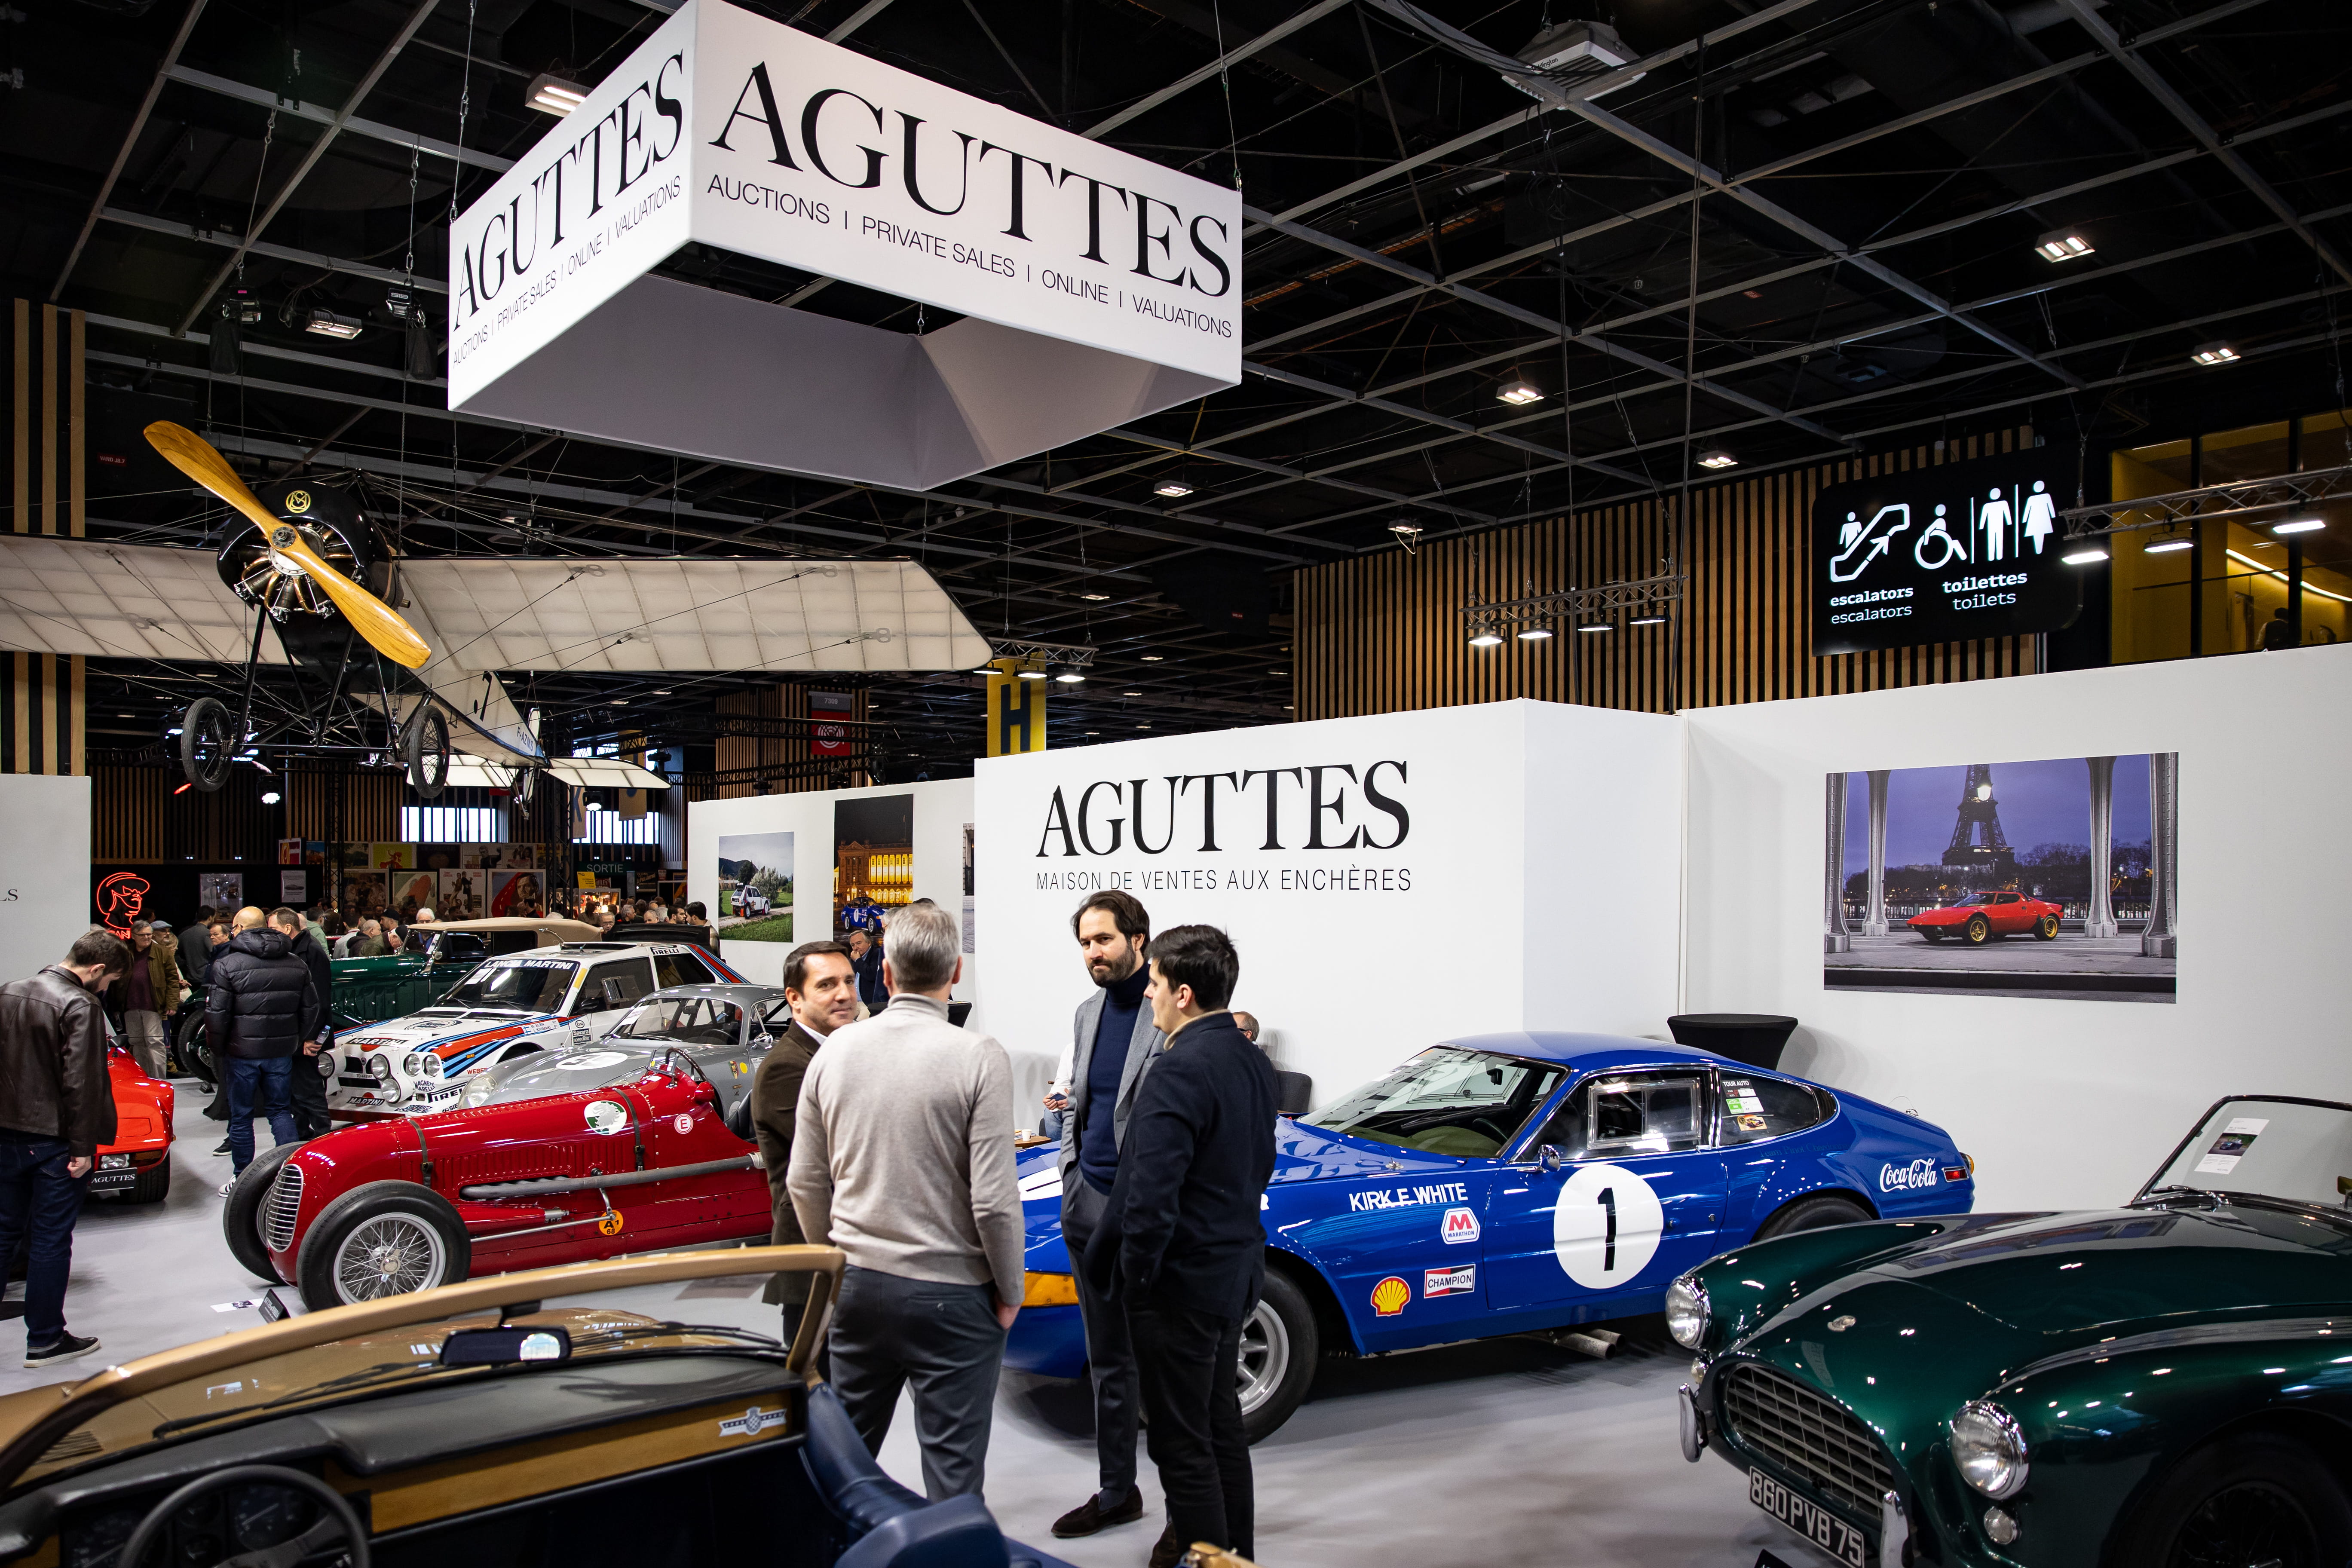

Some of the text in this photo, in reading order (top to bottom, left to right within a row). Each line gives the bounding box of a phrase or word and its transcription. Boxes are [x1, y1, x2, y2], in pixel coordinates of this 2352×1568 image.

[454, 49, 683, 331] AGUTTES
[708, 61, 1231, 297] AGUTTES
[707, 175, 1231, 338] AUCTIONS PRIVATE SALES ONLINE VALUATIONS
[453, 175, 680, 369] AUCTIONS PRIVATE SALES ONLINE VALUATIONS
[1942, 573, 2027, 593] toilettes
[1830, 588, 1914, 607] escalators
[1953, 593, 2016, 610] toilets
[1831, 606, 1912, 624] escalators
[1000, 680, 1031, 755] H
[517, 726, 534, 752] F-AZMS
[1035, 760, 1410, 857] AGUTTES
[586, 864, 623, 873] SORTIE
[1037, 864, 1410, 891] MAISON DE VENTES AUX ENCHÈRES
[650, 945, 680, 955] PIRELLI
[484, 960, 574, 970] LANCIA MARTINI
[427, 1081, 467, 1103] PIRE
[680, 1118, 688, 1129] E
[91, 1174, 135, 1183] AGUTTES
[1349, 1190, 1391, 1211] KIRK
[1412, 1182, 1468, 1205] WHITE
[1449, 1214, 1473, 1231] M
[1597, 1188, 1616, 1271] 1
[1427, 1274, 1472, 1288] CHAMPION
[1751, 1472, 1862, 1566] 860 PVB 75
